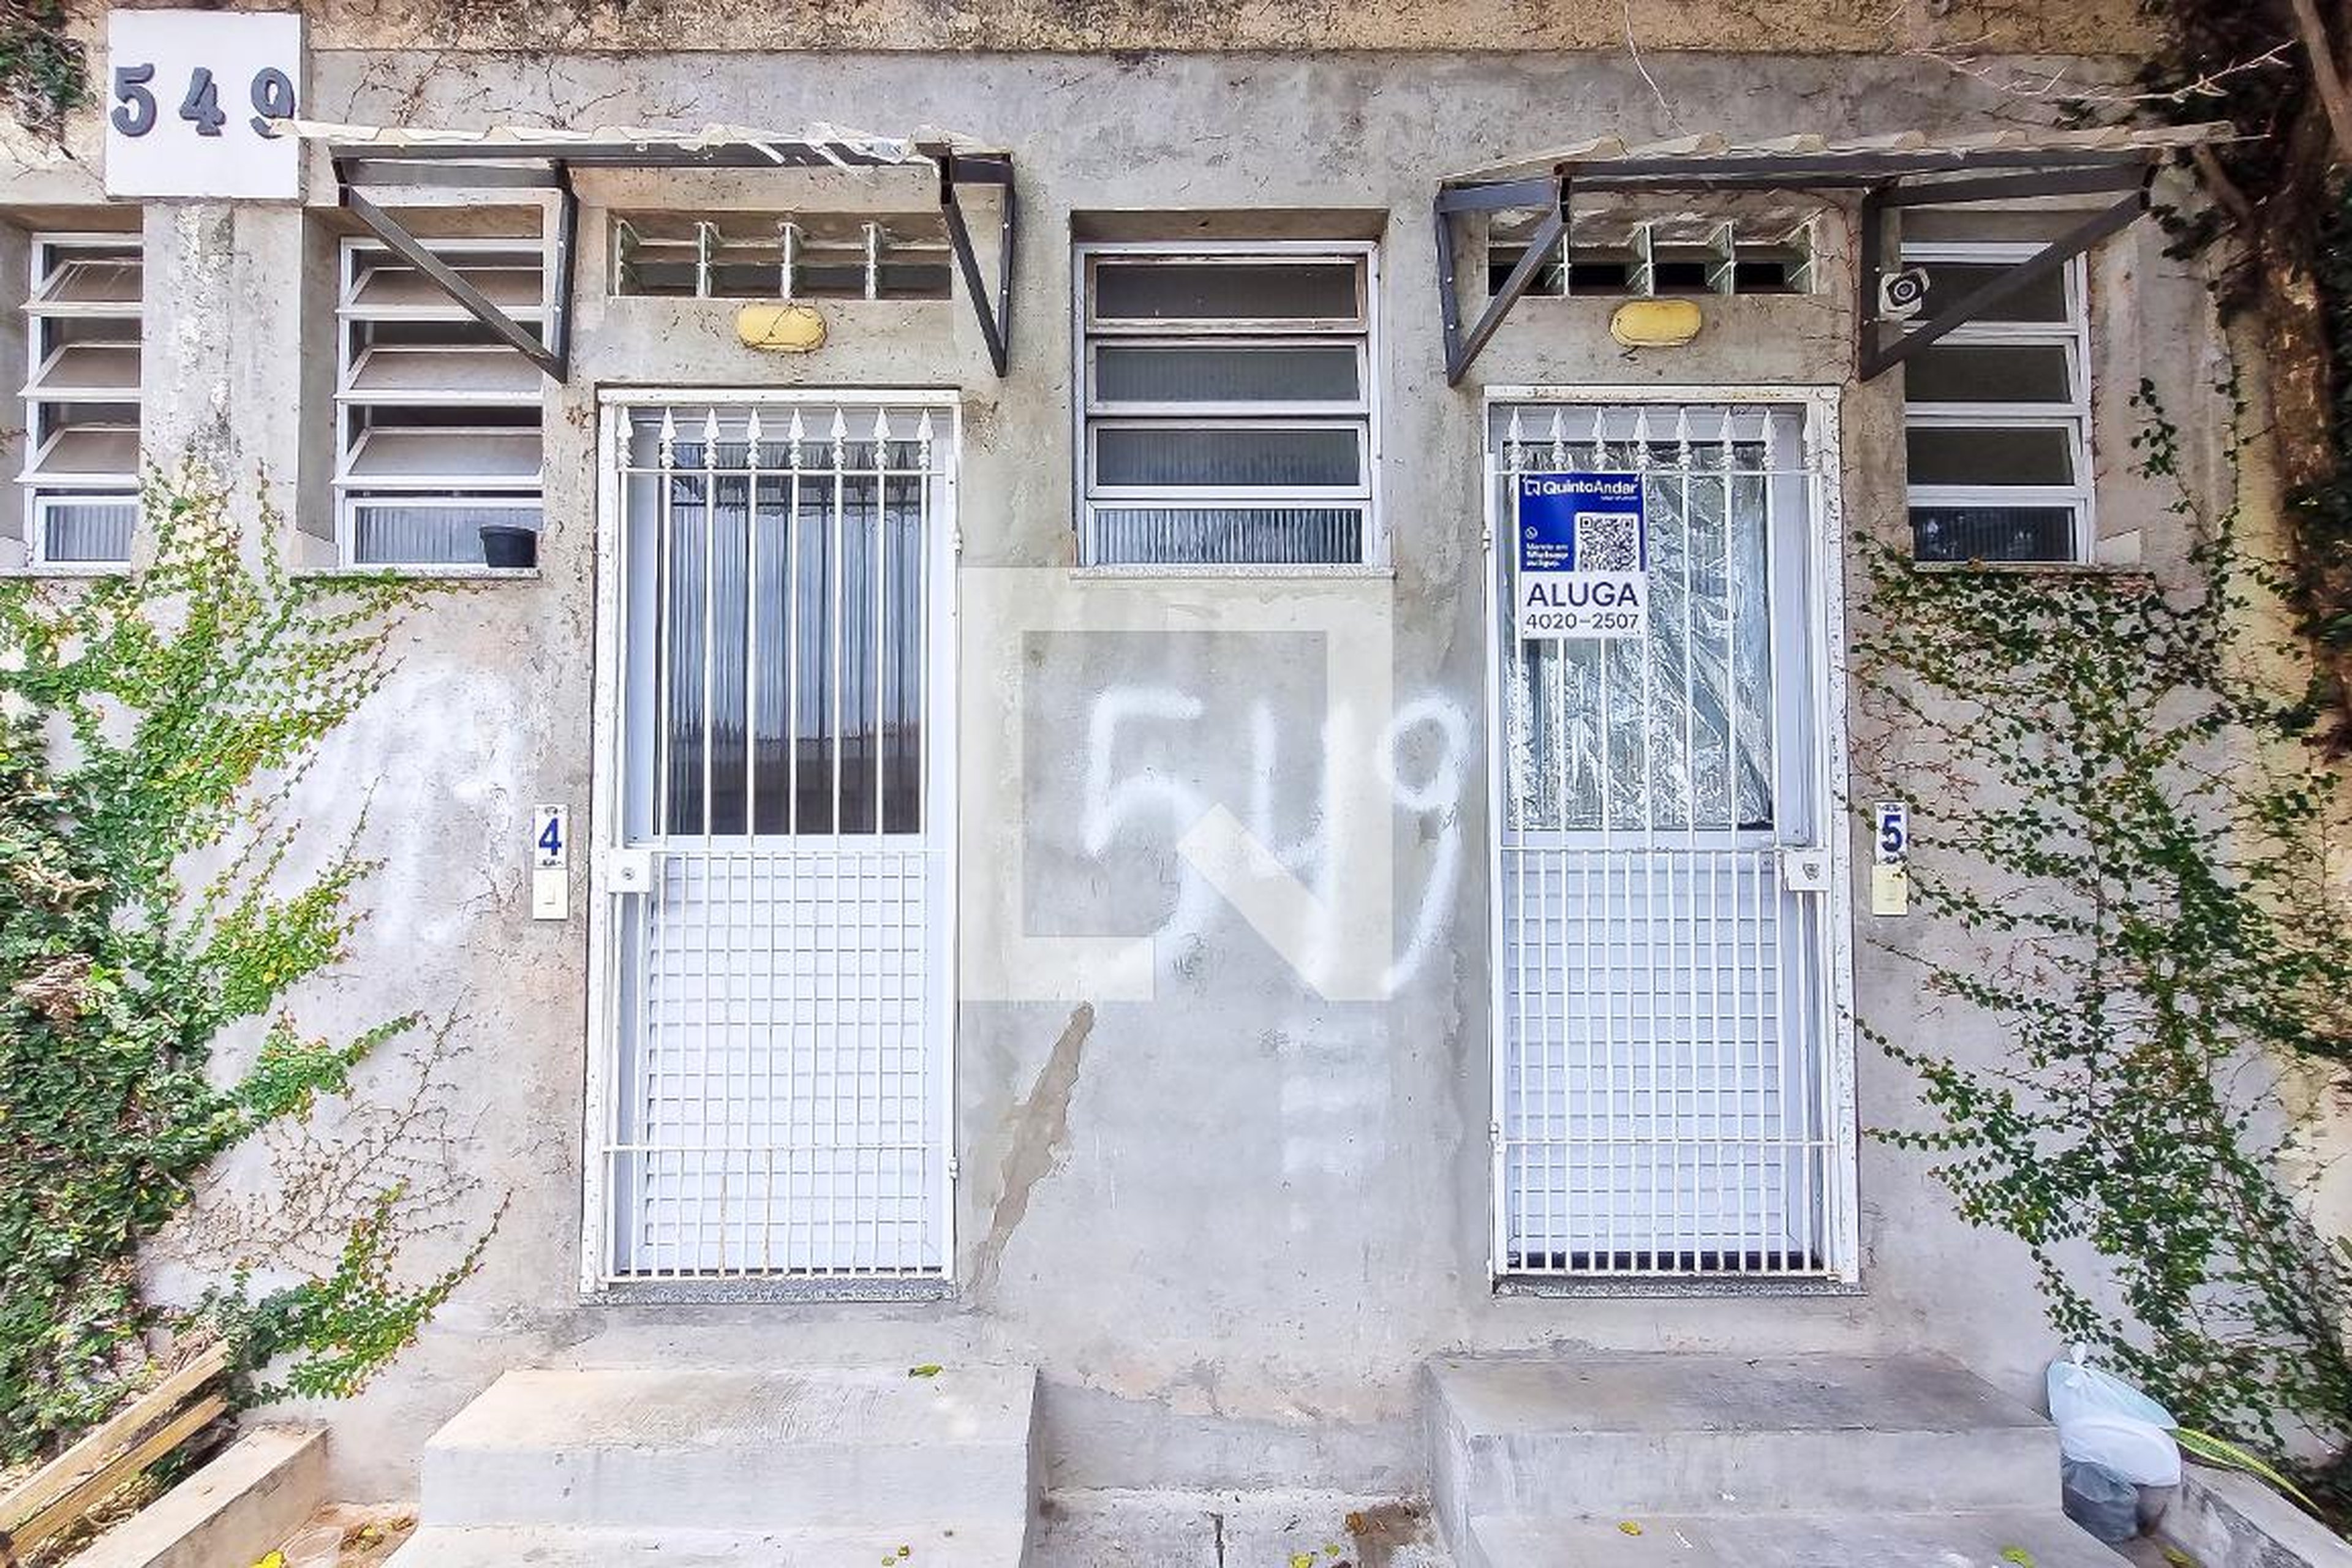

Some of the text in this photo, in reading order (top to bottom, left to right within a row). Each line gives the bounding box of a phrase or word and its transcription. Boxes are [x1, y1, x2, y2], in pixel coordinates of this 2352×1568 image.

[111, 62, 295, 139] 549
[1543, 479, 1638, 495] QuintoAndar
[1527, 582, 1640, 606] ALUGA
[1526, 613, 1639, 630] 4020-2507
[538, 817, 562, 856] 4
[1882, 814, 1902, 852] 5
